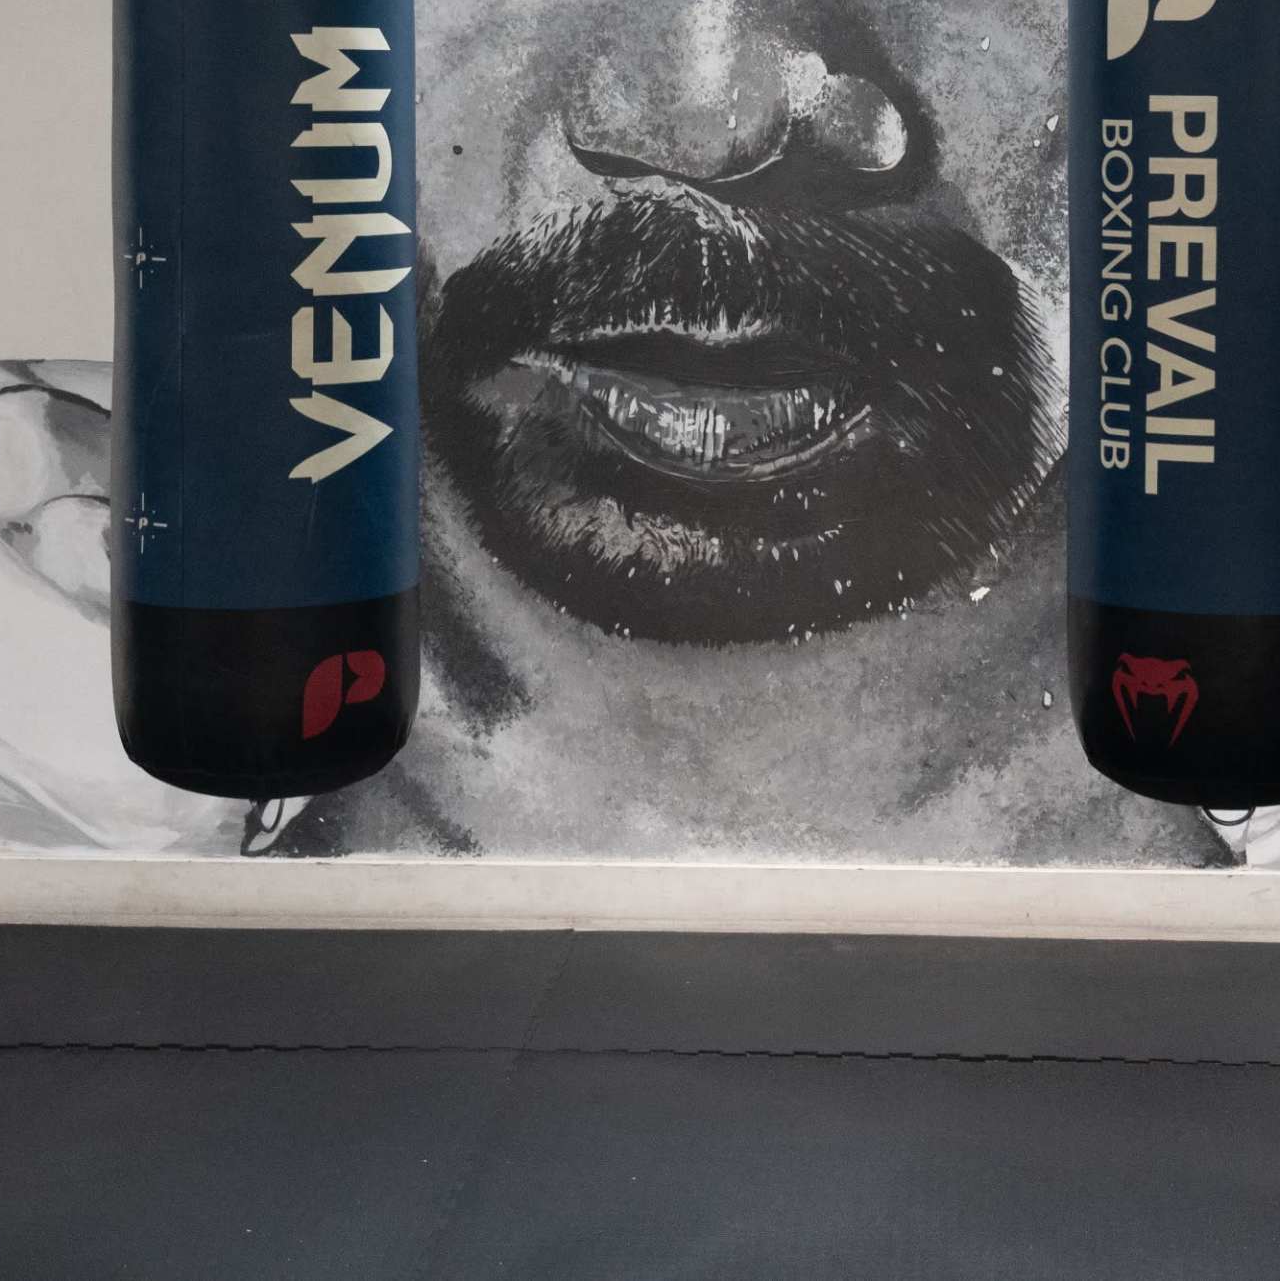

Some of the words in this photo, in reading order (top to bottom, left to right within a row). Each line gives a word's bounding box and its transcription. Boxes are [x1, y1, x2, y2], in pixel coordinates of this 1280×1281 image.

[288, 26, 413, 484] VENUM
[1100, 118, 1134, 322] BOXING
[1144, 94, 1219, 496] PREVAIL
[1099, 337, 1132, 470] CLUB
